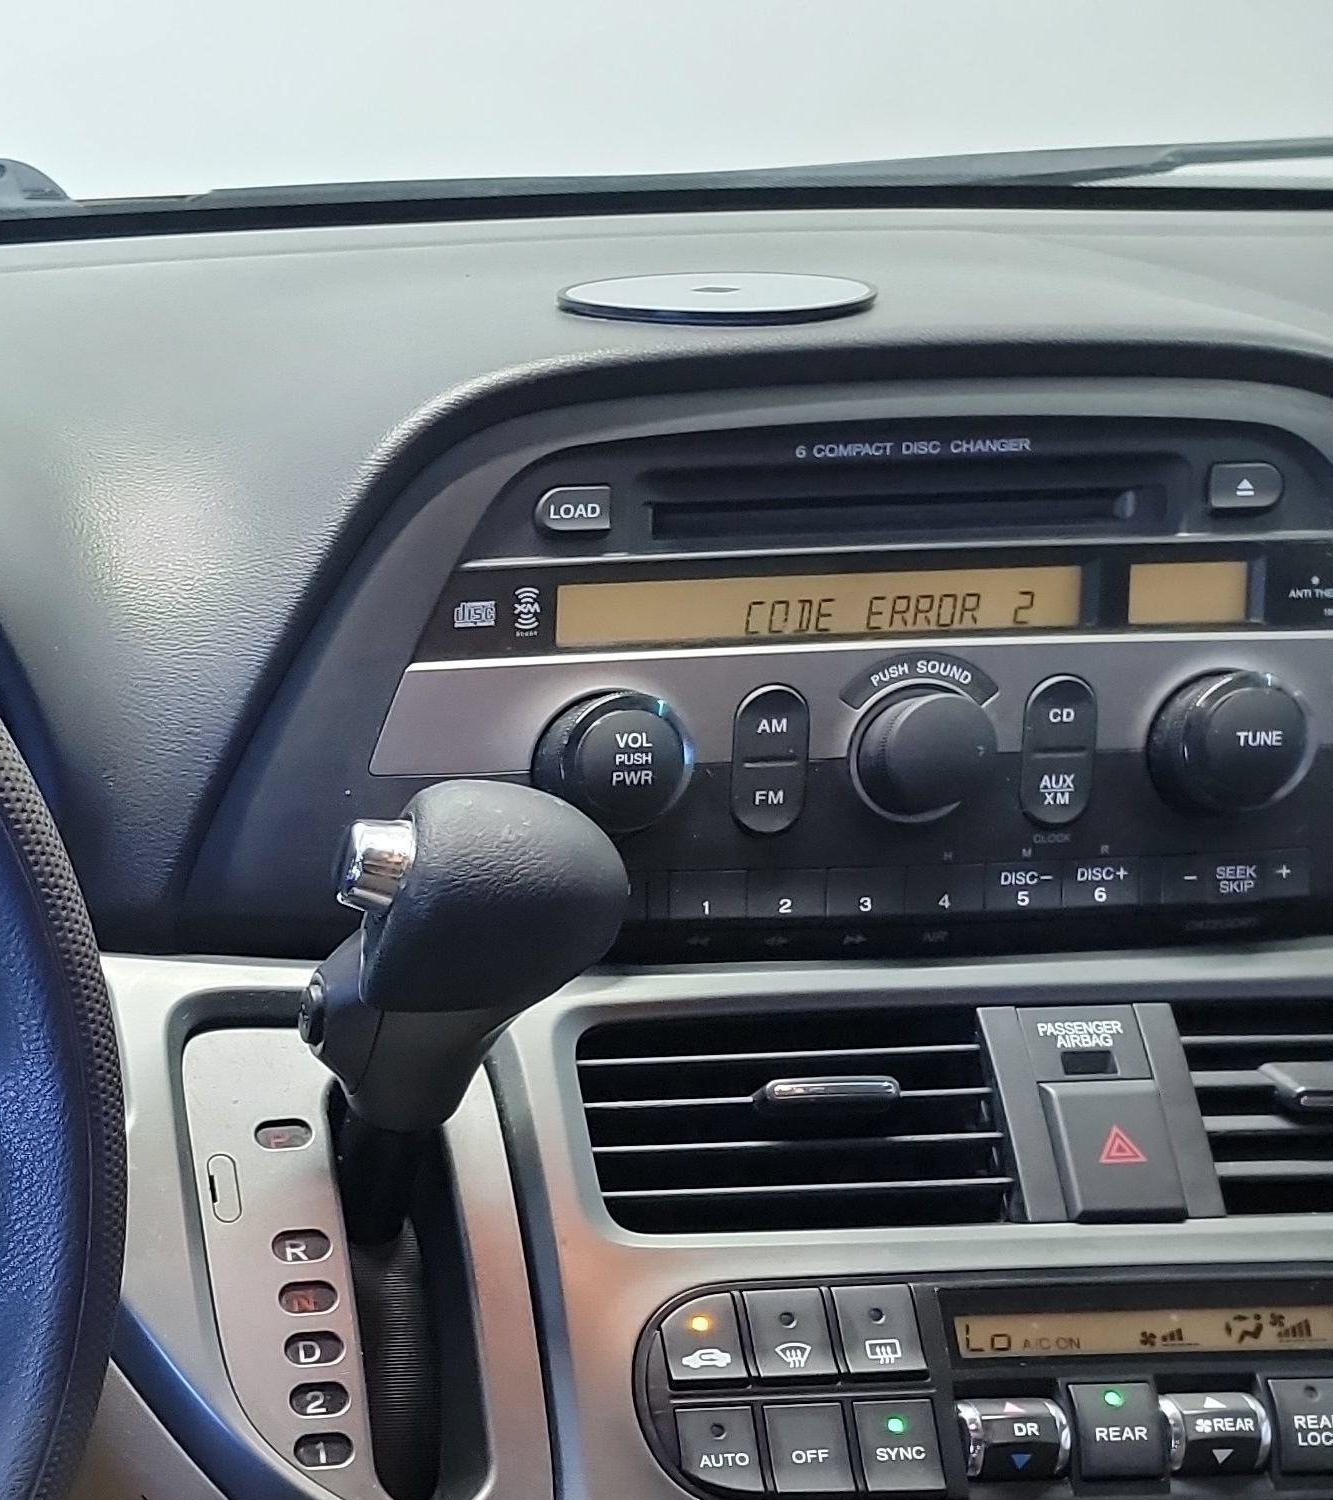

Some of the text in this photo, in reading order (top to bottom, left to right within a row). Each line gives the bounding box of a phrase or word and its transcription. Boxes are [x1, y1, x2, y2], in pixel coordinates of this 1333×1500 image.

[795, 438, 1031, 459] 6 COMPACT DISC CHANGER
[549, 503, 600, 519] LOAD
[745, 591, 1035, 635] CODE ERROR 2
[870, 660, 973, 688] PUSH SOUND
[1048, 708, 1075, 723] CD
[757, 718, 788, 734] AM
[615, 732, 654, 748] VOL
[1236, 731, 1283, 747] TUNE
[615, 753, 653, 766] PUSH
[612, 770, 653, 786] PWR
[1040, 774, 1075, 790] AUX
[754, 790, 784, 806] FM
[1043, 791, 1070, 805] XM
[1033, 832, 1072, 844] CLOCK
[1215, 865, 1257, 880] SEEK
[1219, 880, 1255, 894] SKIP
[701, 887, 1107, 915] 1 2 3 4 5 6
[1036, 1021, 1124, 1036] PASSENGER
[1056, 1034, 1113, 1048] AIRBAG
[284, 1239, 310, 1261] R
[292, 1289, 317, 1312] N
[1055, 1336, 1081, 1350] ON
[297, 1341, 322, 1364] D
[306, 1391, 328, 1414] 2
[1013, 1422, 1040, 1437] DR
[1213, 1417, 1255, 1432] REAR
[1293, 1415, 1333, 1430] REA
[1095, 1426, 1148, 1442] REAR
[316, 1440, 328, 1464] 1
[699, 1452, 750, 1468] AUTO
[792, 1449, 830, 1464] OFF
[876, 1446, 927, 1462] SYNC
